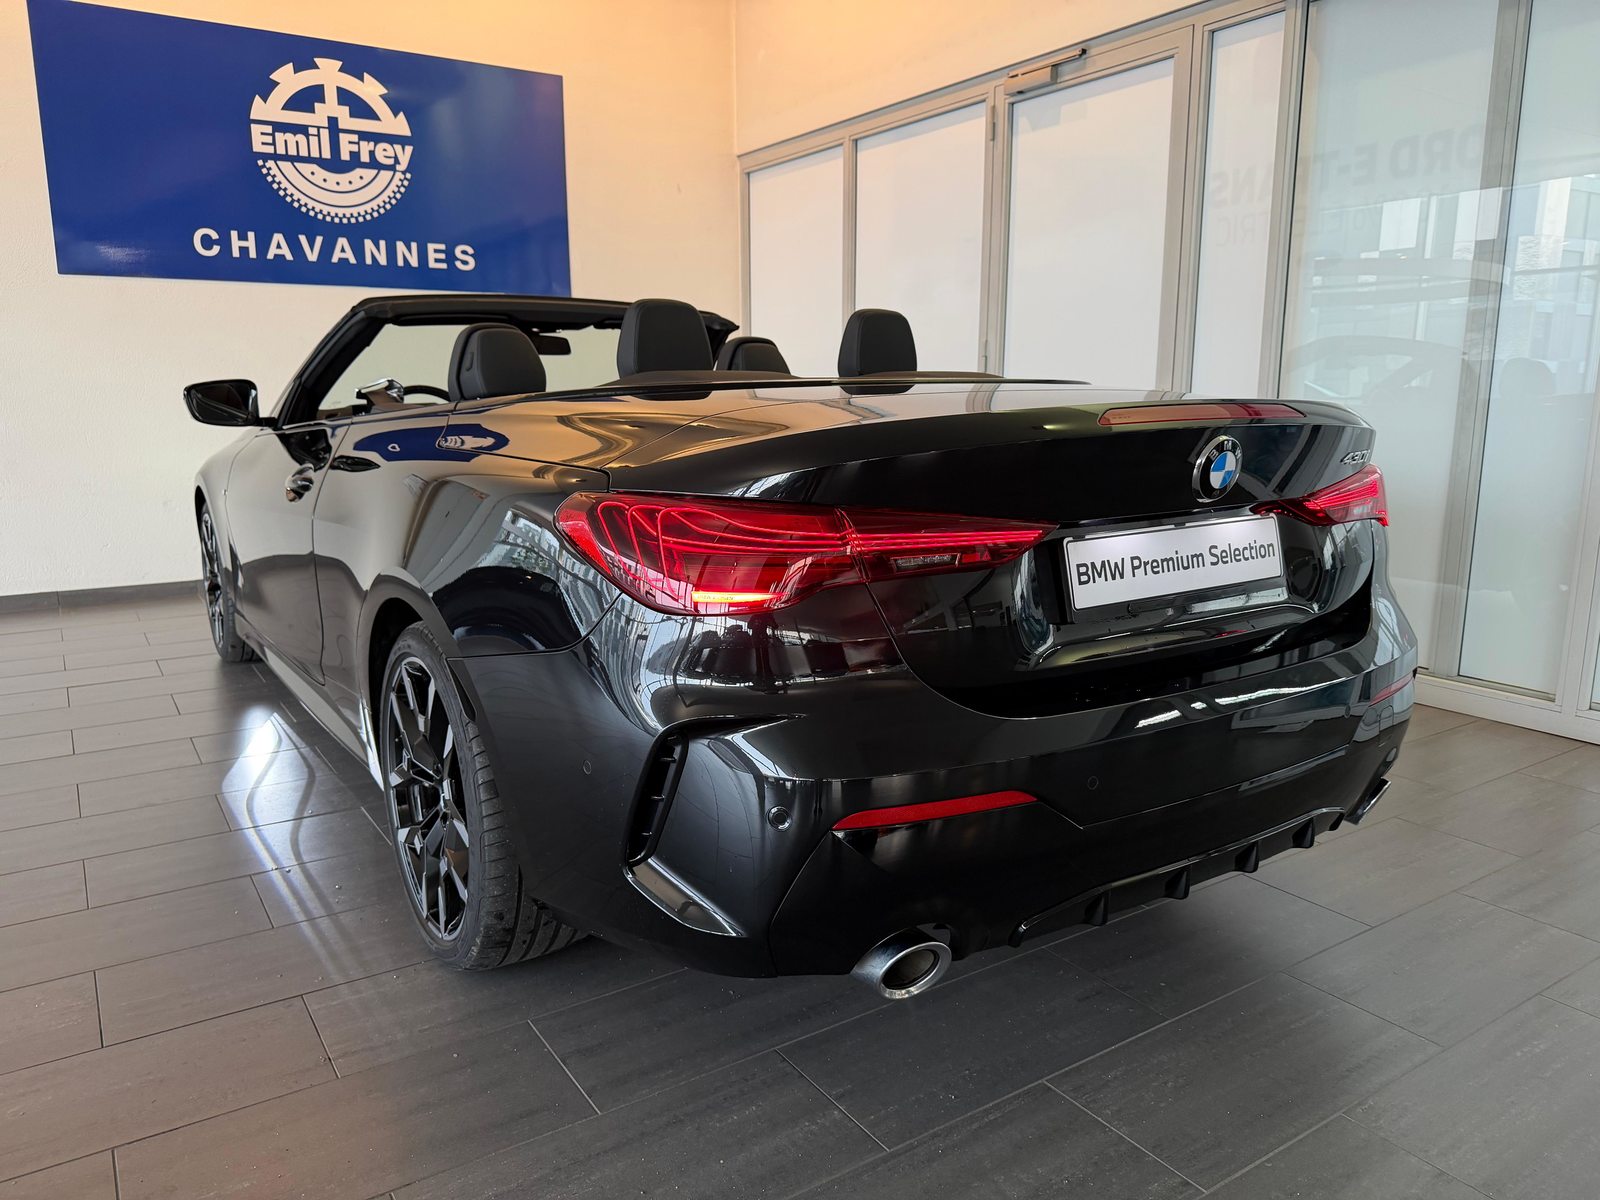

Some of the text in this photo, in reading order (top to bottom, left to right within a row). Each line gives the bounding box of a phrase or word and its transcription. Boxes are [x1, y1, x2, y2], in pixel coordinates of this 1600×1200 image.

[251, 123, 413, 172] Emil Frey
[193, 227, 476, 271] CHAVANNES
[1208, 440, 1242, 461] BMW
[1076, 540, 1275, 586] BMW Premium Selection
